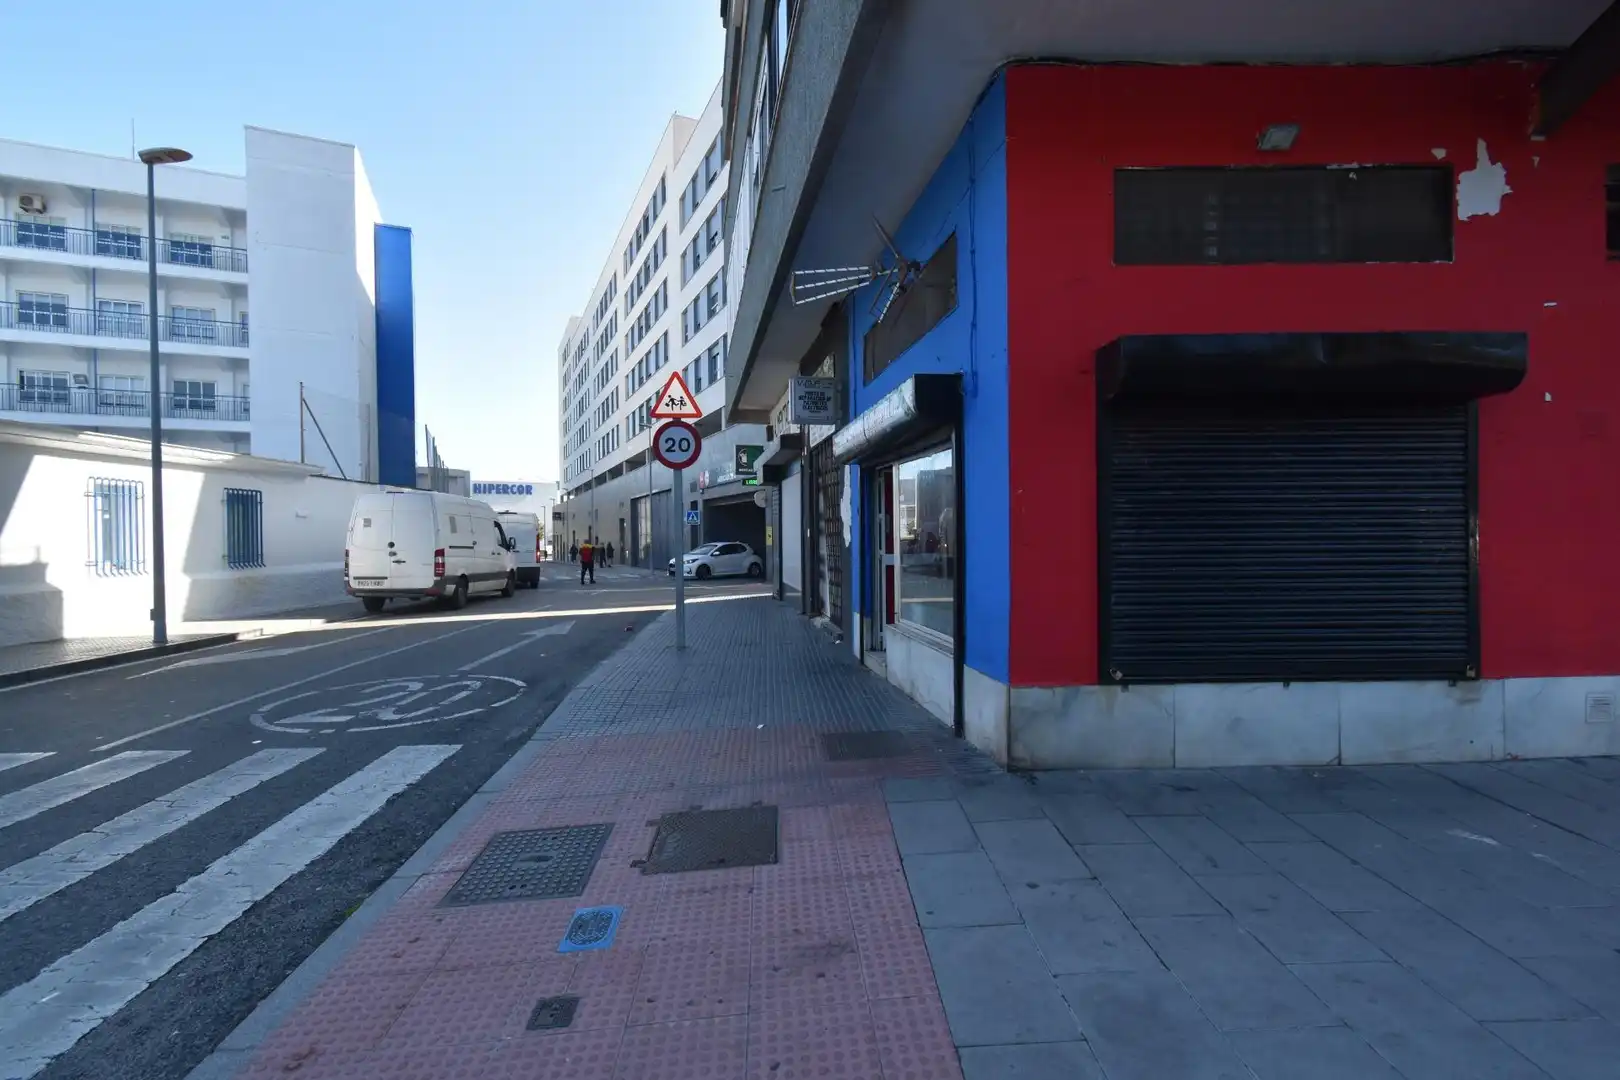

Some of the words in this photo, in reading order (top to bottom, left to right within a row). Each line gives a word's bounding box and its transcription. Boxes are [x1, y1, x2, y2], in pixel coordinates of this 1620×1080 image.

[664, 437, 691, 453] 20
[473, 483, 533, 495] HIPERCOR
[273, 680, 482, 723] 20
